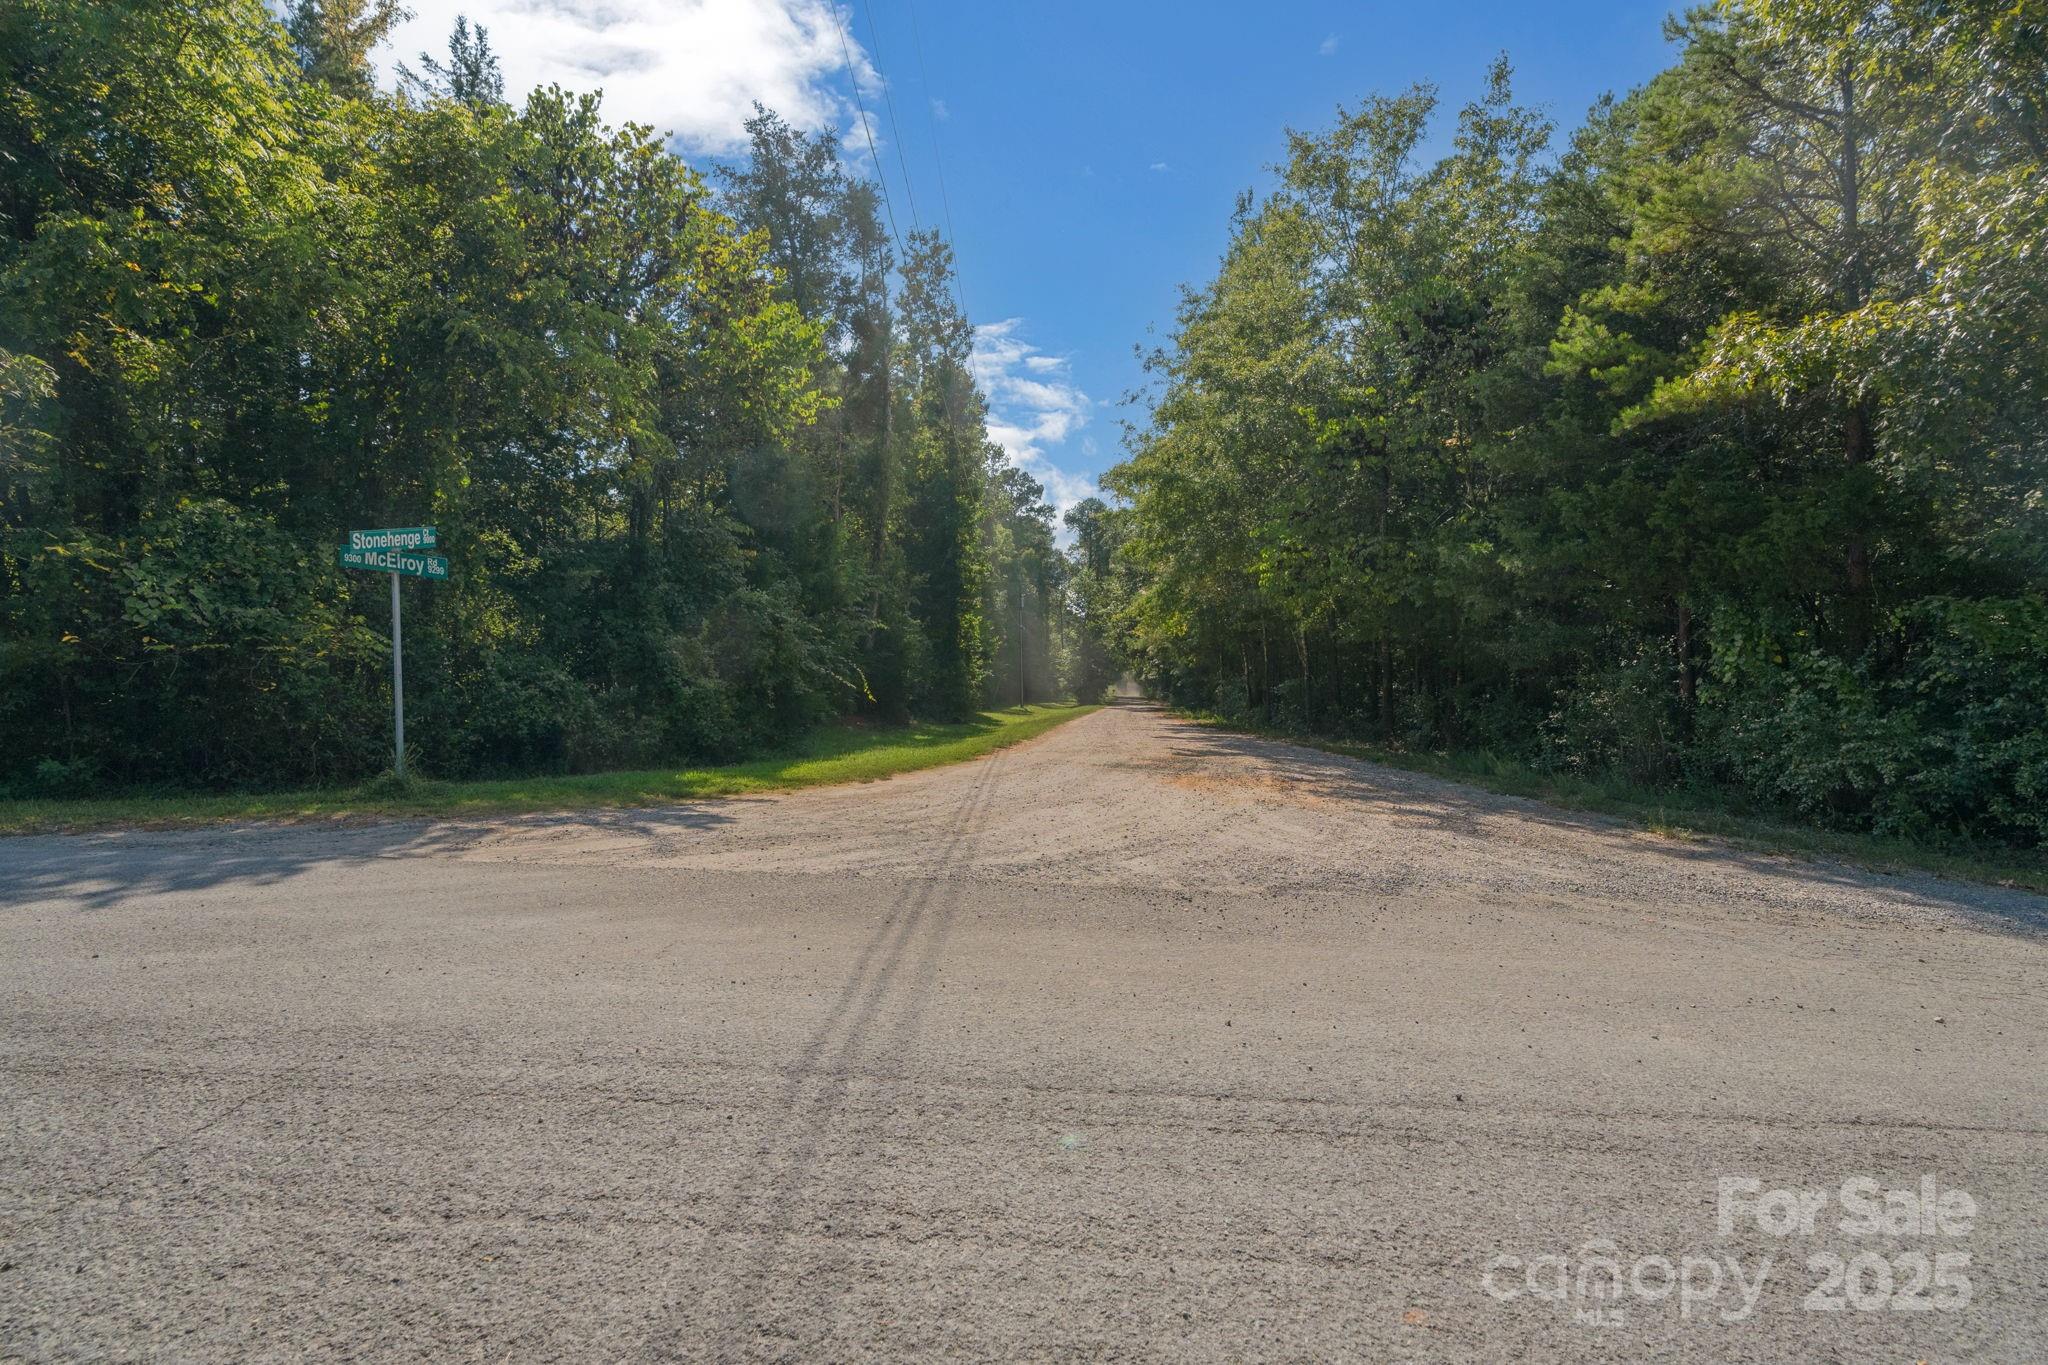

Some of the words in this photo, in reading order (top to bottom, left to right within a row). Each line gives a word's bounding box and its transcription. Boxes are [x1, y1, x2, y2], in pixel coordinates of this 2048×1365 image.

[352, 531, 421, 549] Stonehenge
[344, 553, 362, 563] 9300
[364, 551, 425, 575] McElroy
[427, 557, 438, 567] Rd
[427, 565, 445, 575] 9299
